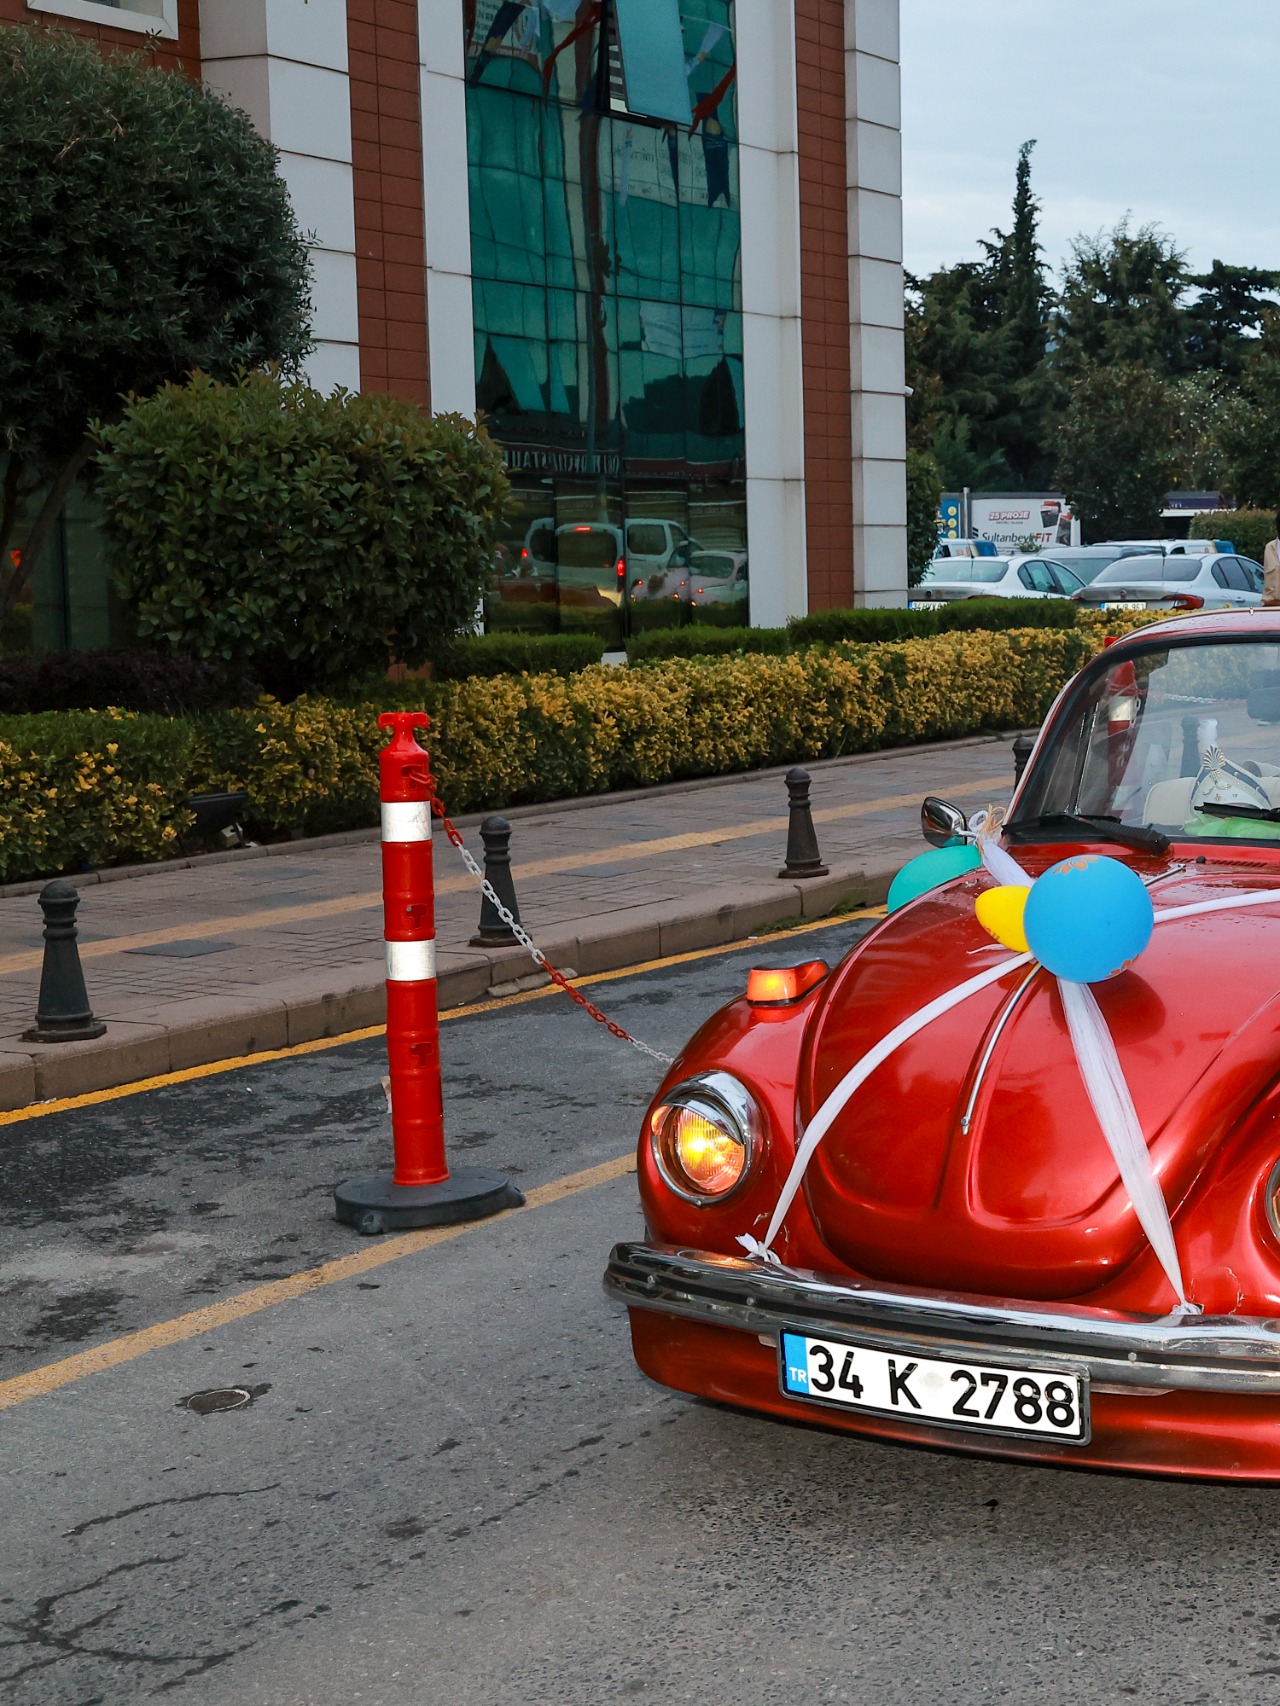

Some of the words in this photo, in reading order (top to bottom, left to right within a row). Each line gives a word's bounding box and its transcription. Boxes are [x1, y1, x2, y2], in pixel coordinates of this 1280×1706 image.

[988, 511, 1000, 521] 25
[1000, 510, 1031, 520] PROJE
[788, 1366, 809, 1384] TR
[809, 1344, 864, 1399] 34
[888, 1358, 922, 1409] K
[950, 1369, 1075, 1428] 2788
